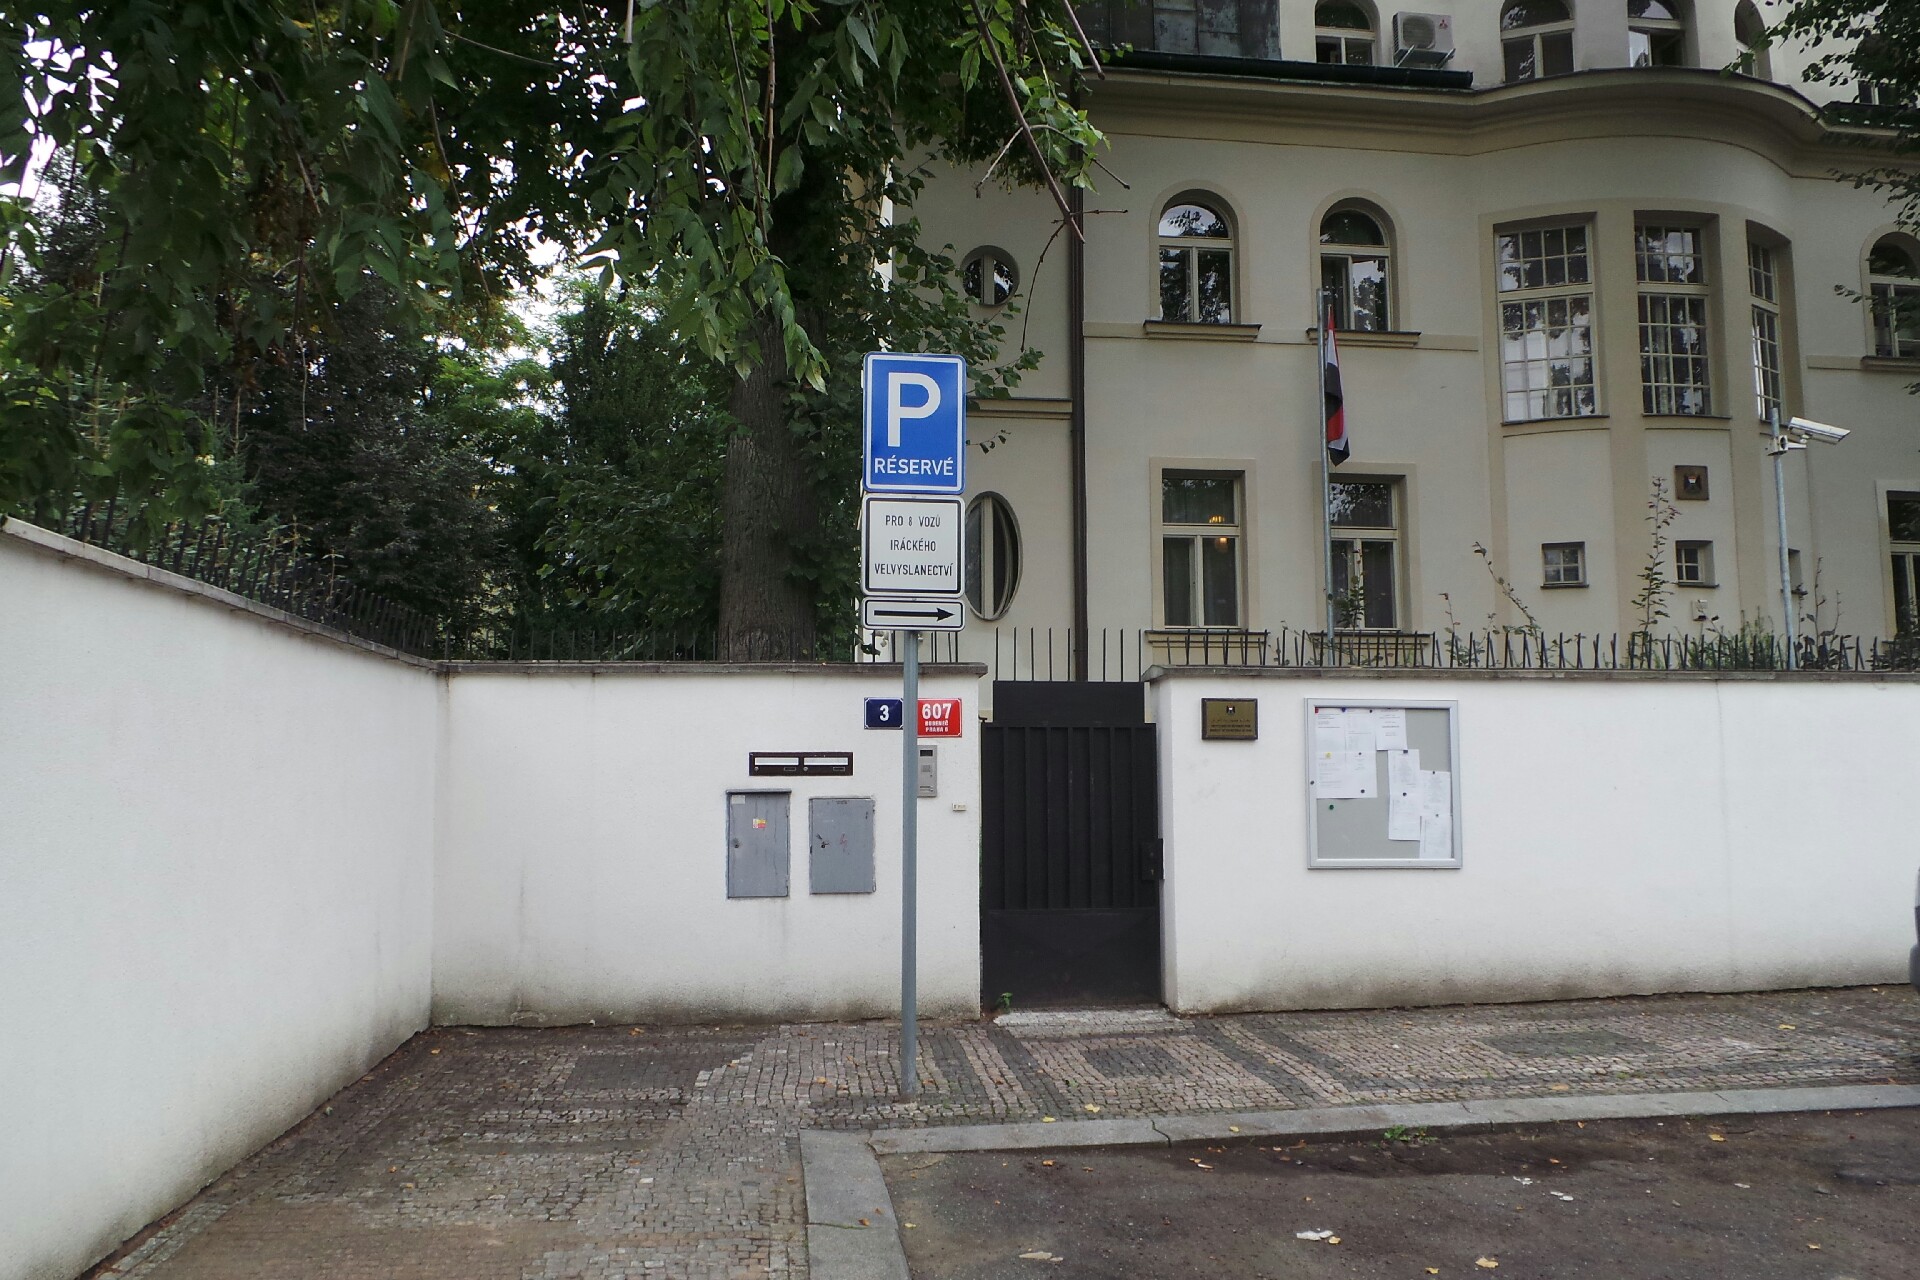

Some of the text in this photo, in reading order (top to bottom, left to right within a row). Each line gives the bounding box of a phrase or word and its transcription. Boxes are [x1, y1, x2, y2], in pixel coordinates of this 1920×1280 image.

[888, 372, 941, 447] P
[874, 455, 954, 476] RÉSERVÉ
[885, 515, 904, 526] PRO
[908, 516, 913, 527] 8
[890, 537, 936, 552] IRÁCKÉHO
[874, 562, 954, 576] VELVYSLANECTVÍ
[879, 704, 890, 722] 3
[922, 703, 952, 720] 607
